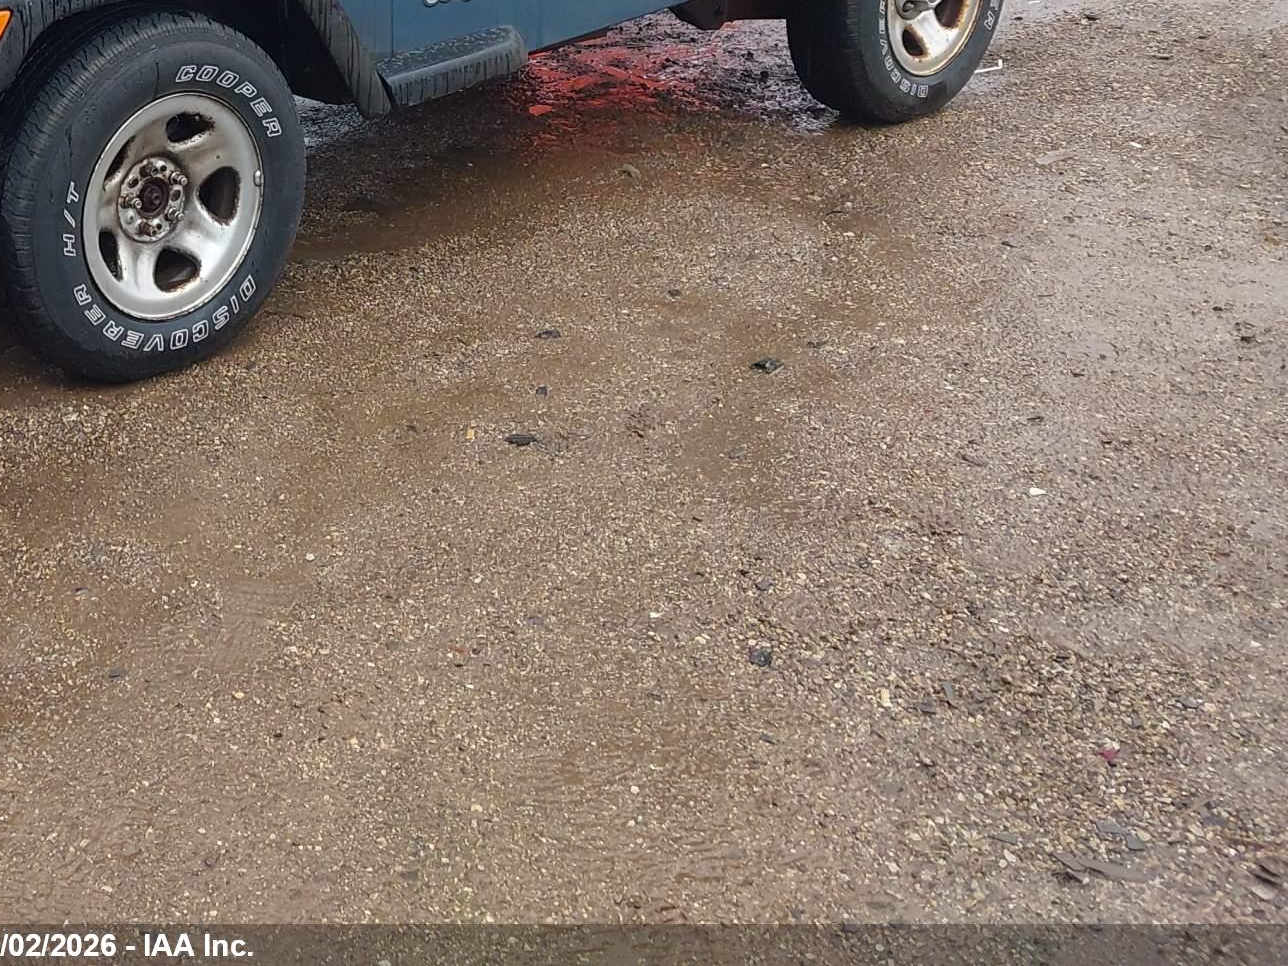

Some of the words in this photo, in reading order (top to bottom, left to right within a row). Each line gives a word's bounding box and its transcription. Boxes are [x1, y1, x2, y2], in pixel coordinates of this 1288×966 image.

[175, 65, 282, 137] COOPER
[62, 180, 80, 257] H/T
[72, 274, 256, 352] DISCOVERER
